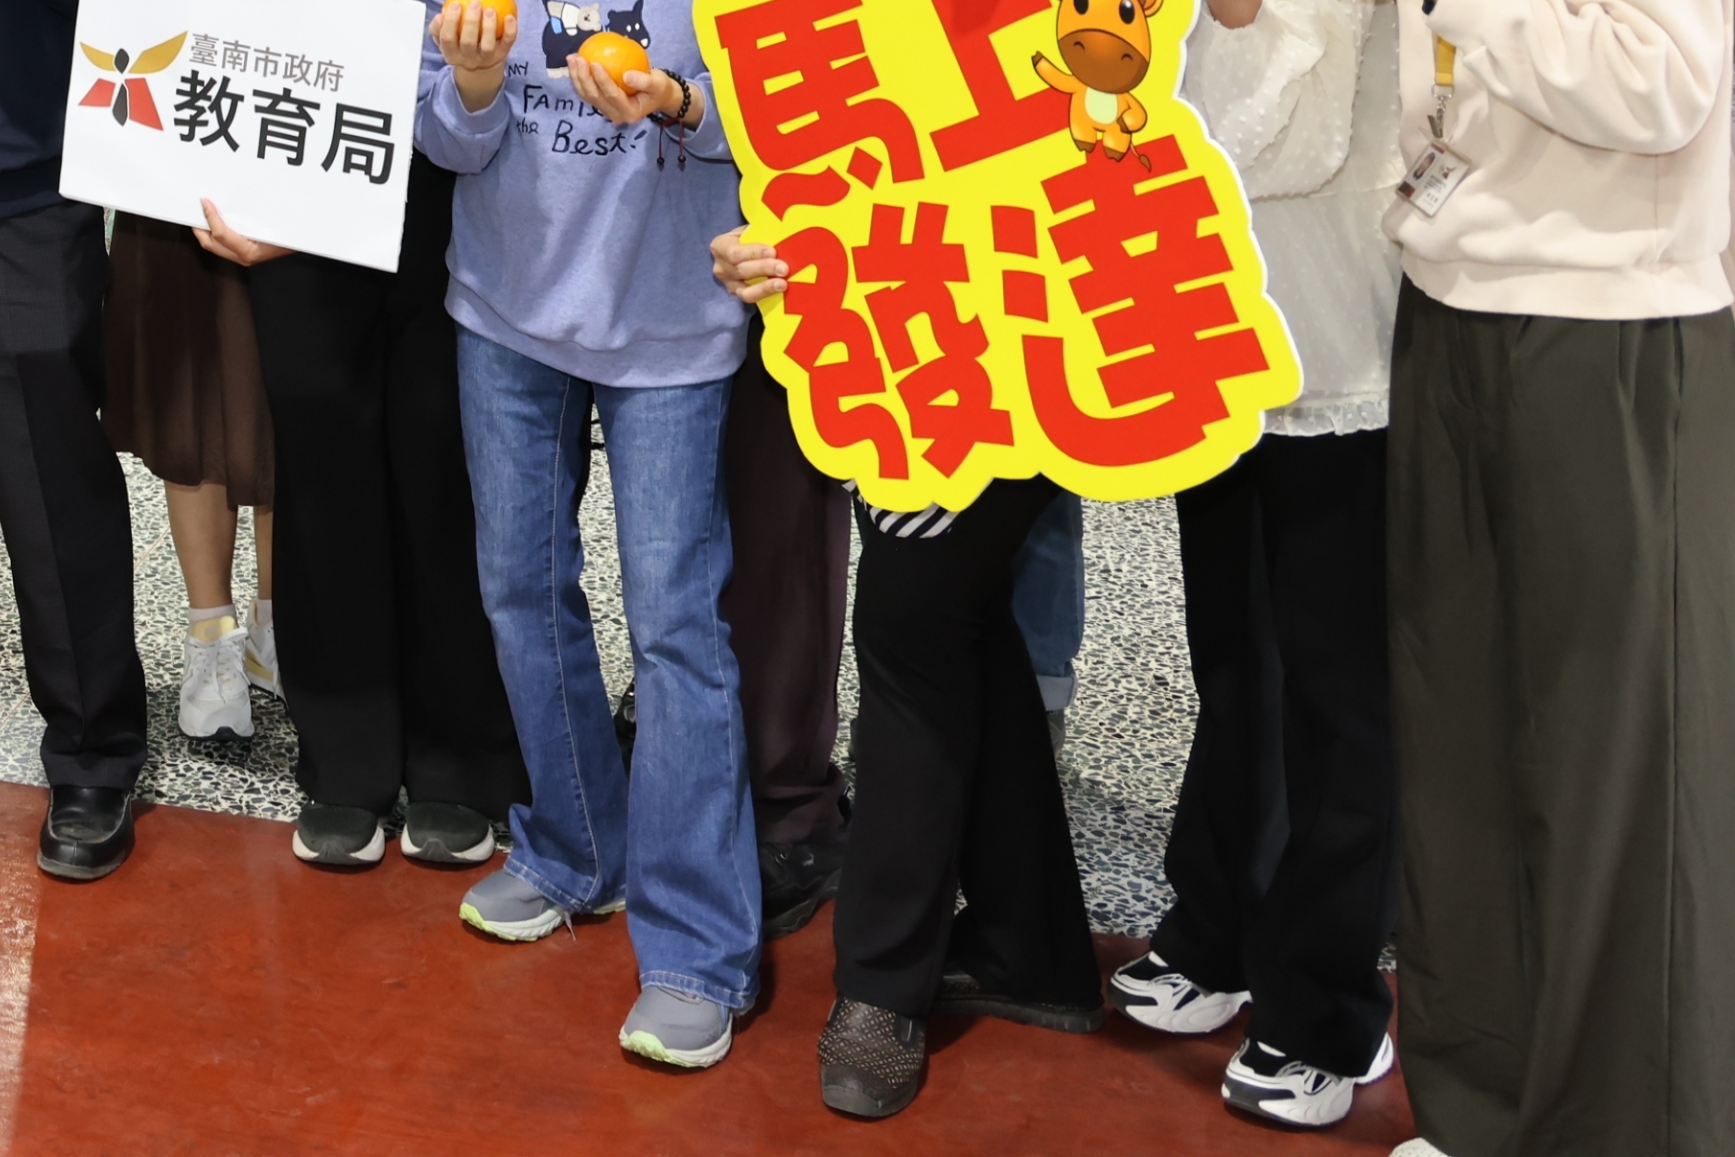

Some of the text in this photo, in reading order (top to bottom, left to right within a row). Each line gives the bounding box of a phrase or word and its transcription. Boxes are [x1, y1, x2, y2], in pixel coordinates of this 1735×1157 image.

[188, 32, 345, 93] 臺南市政府
[173, 68, 396, 186] 教育局
[516, 116, 648, 156] the Best!
[772, 133, 1271, 481] 發達
